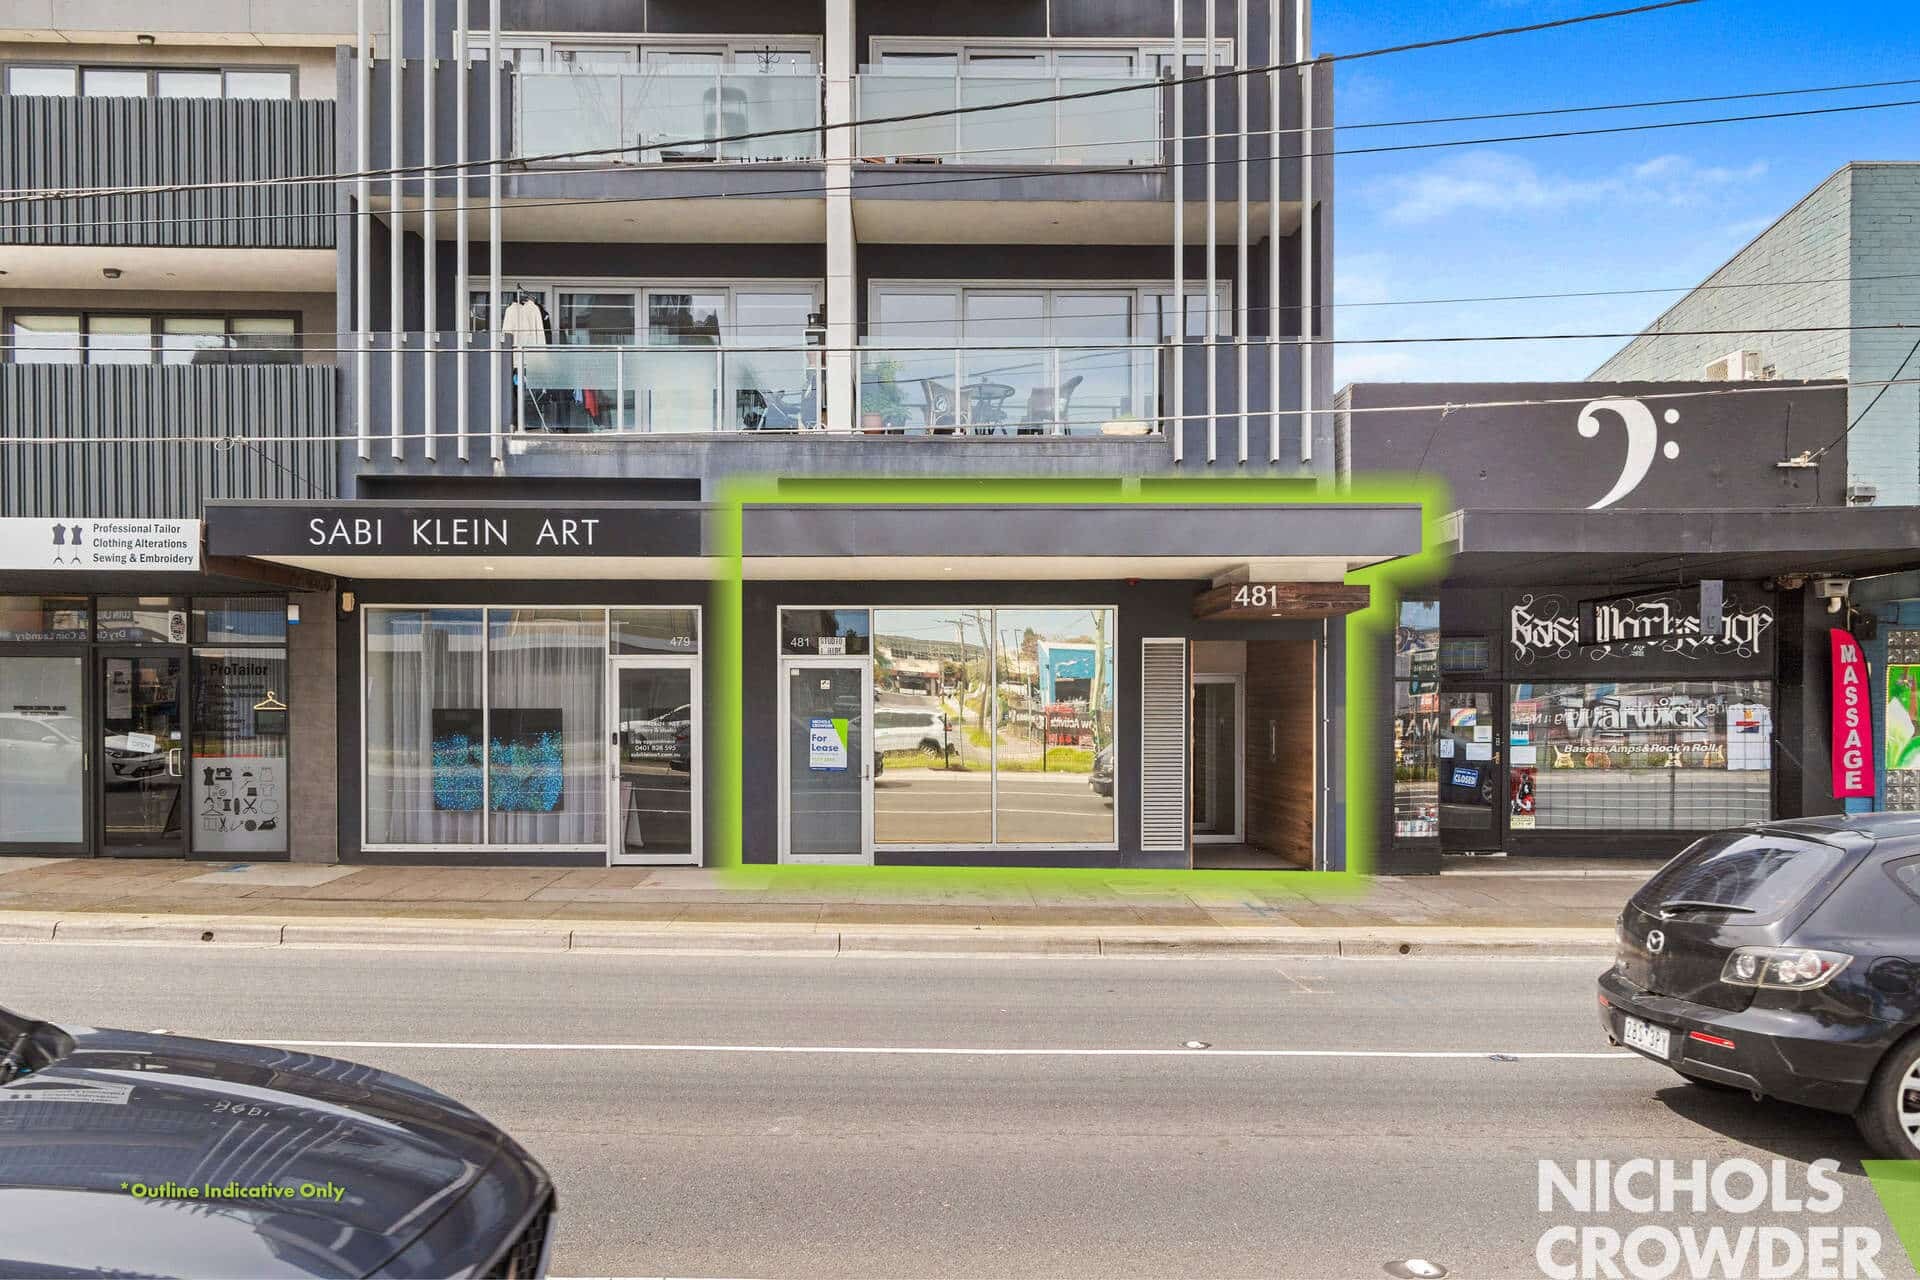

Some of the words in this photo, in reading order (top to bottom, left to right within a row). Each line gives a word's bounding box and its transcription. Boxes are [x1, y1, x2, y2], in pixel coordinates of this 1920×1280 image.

[93, 523, 152, 533] Professional
[154, 524, 181, 533] Tailor
[309, 518, 382, 545] SABI
[413, 518, 508, 545] KLEIN
[535, 518, 600, 545] ART
[93, 538, 132, 549] Clothing
[135, 538, 187, 548] Alterations
[93, 553, 127, 564] Sewing
[129, 553, 137, 563] &
[140, 553, 194, 565] Embroidery
[1234, 585, 1278, 607] 481
[670, 637, 690, 647] 479
[790, 637, 809, 647] 481
[209, 663, 268, 676] ProTailor
[1840, 644, 1863, 790] MASSAGE
[811, 734, 827, 742] For
[811, 743, 839, 752] Lease
